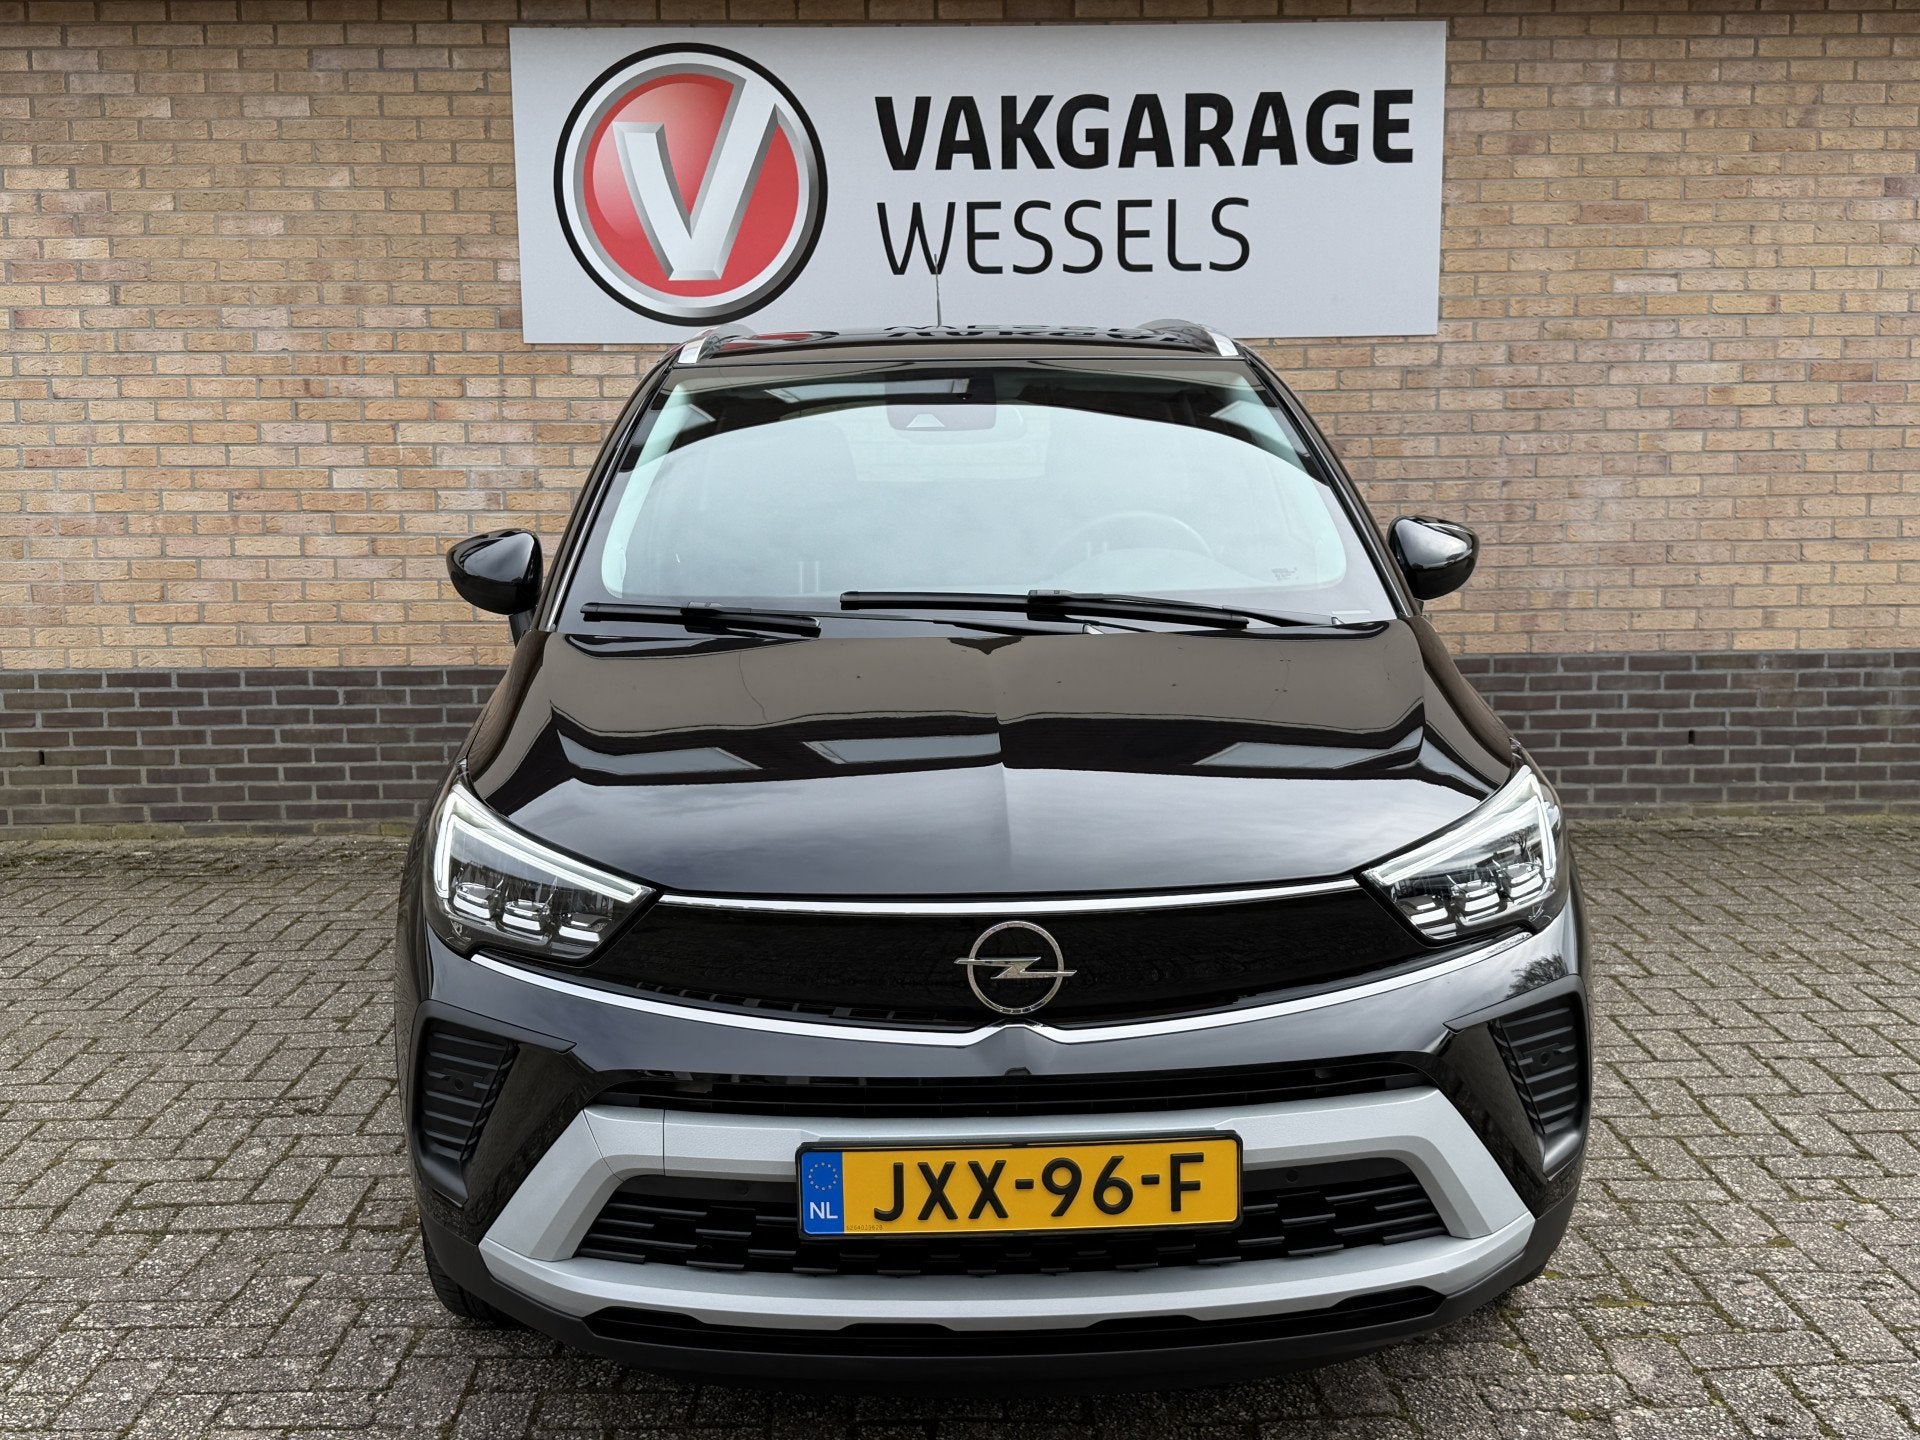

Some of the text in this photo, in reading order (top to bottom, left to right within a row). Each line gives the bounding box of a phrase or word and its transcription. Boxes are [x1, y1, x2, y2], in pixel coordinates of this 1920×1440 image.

[875, 89, 1414, 171] VAKGARAGE
[610, 74, 780, 281] V
[877, 197, 1250, 276] WESSELS
[809, 1201, 839, 1219] NL
[873, 1151, 1205, 1222] JXX-96-F
